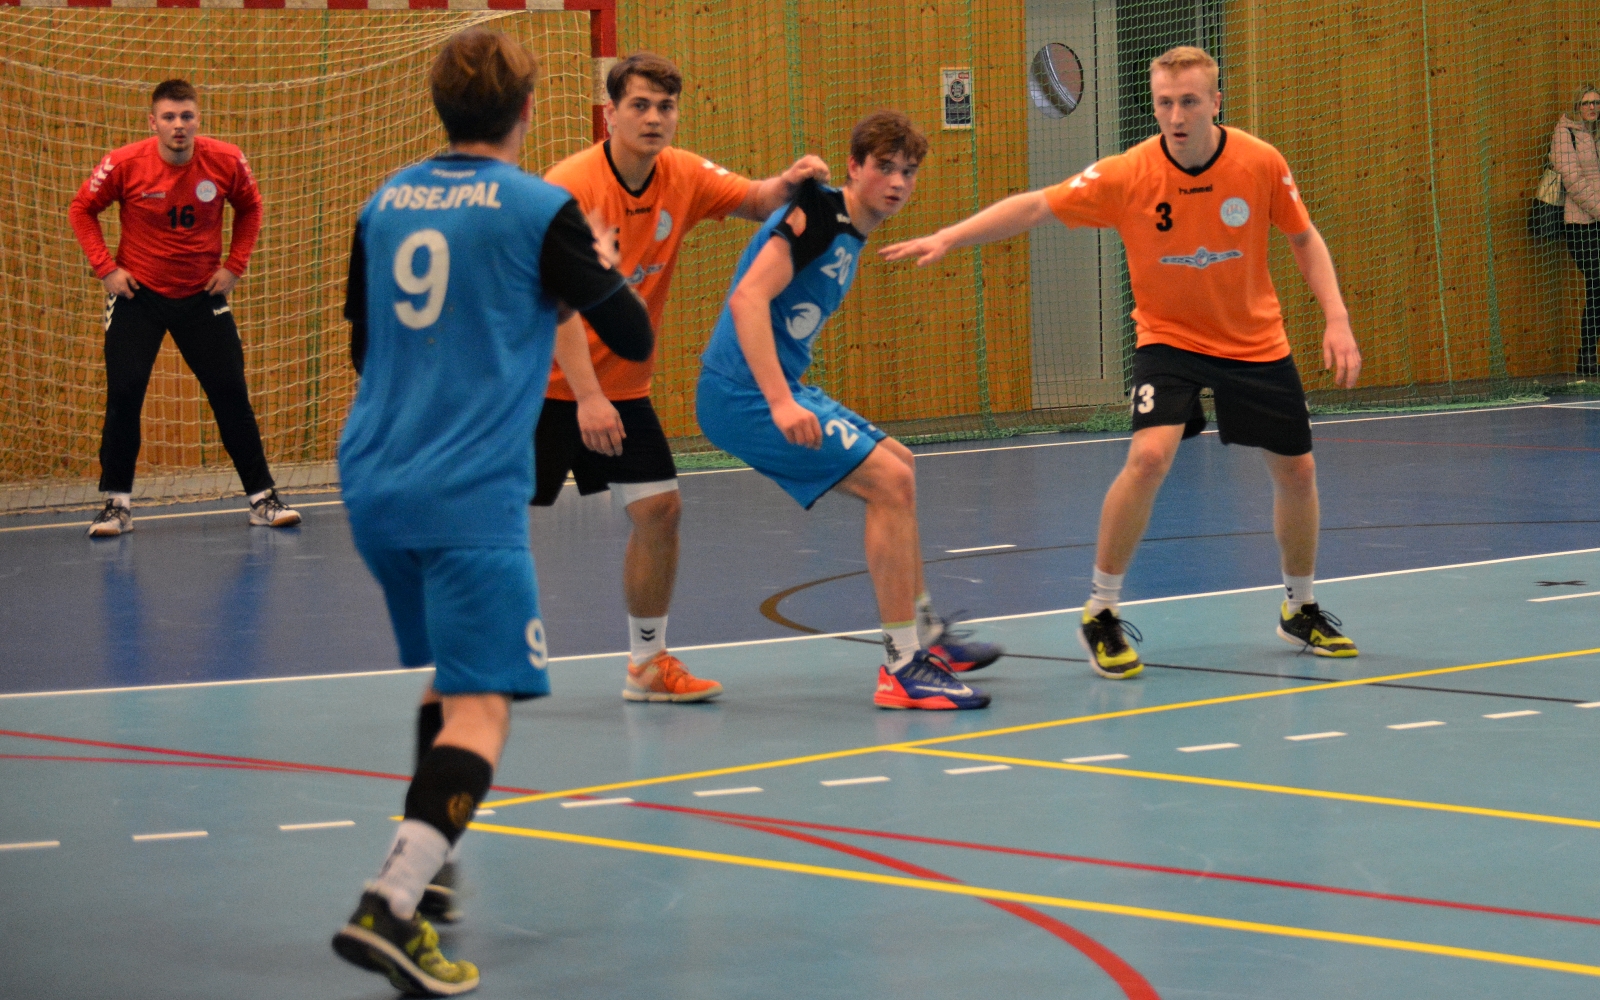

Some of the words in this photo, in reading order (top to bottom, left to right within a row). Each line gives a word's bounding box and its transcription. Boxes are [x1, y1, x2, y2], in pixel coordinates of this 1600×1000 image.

[378, 181, 502, 211] POSEJPAL
[168, 204, 196, 230] 16
[1155, 202, 1173, 232] 3
[393, 228, 450, 330] 9
[525, 617, 548, 669] 9
